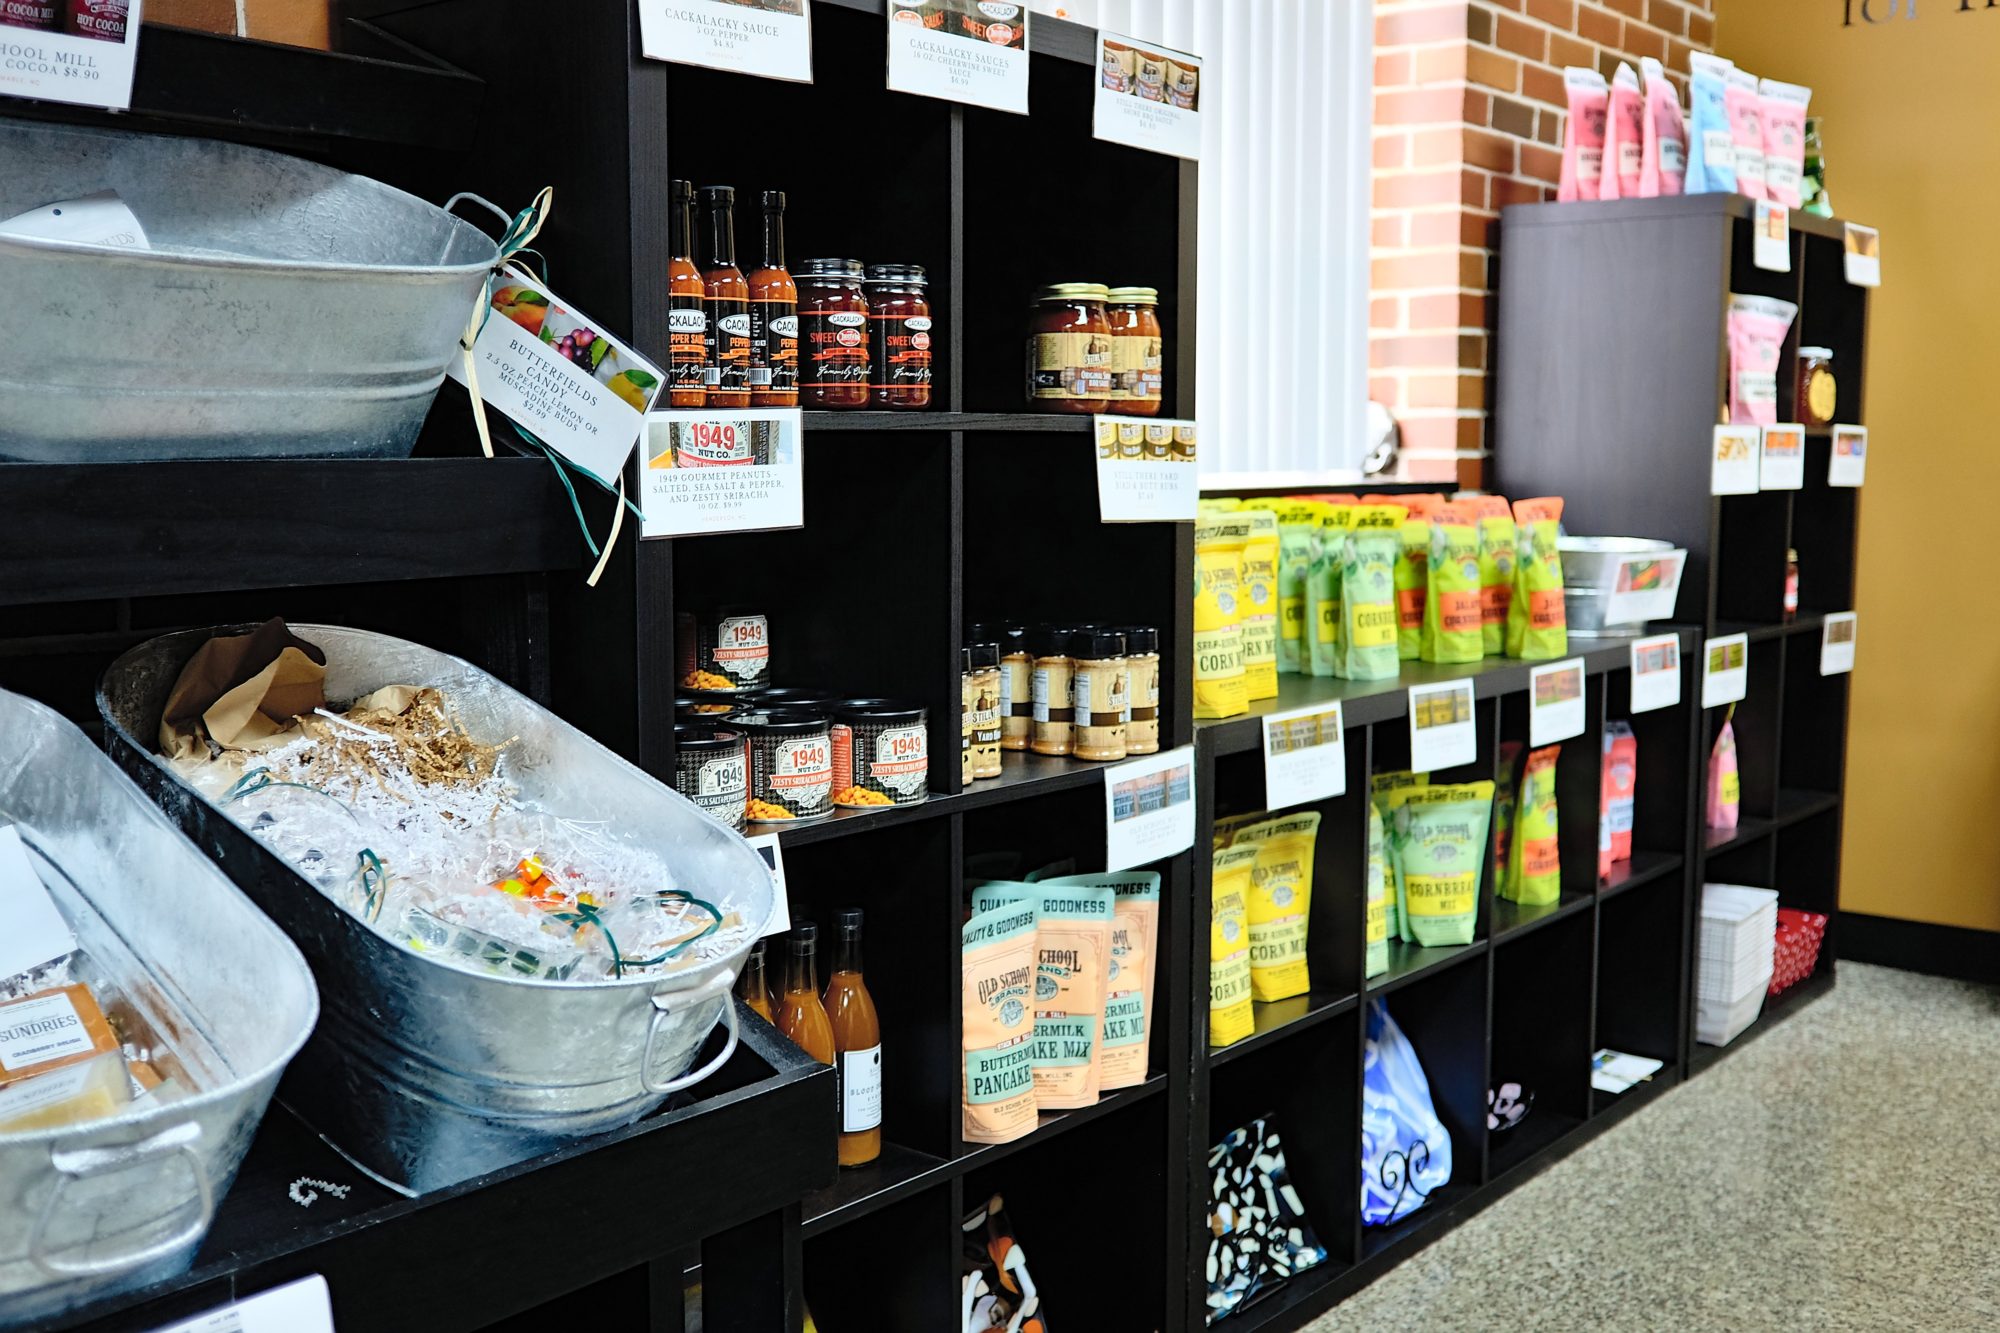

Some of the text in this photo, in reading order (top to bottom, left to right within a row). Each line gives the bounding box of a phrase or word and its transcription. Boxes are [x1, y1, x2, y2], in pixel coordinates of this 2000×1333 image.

[7, 2, 39, 17] COCOA
[77, 13, 125, 33] HOT COCOA
[665, 8, 739, 31] CACKALACKY
[743, 22, 779, 37] SAUCE
[55, 51, 97, 68] MILL
[910, 38, 1010, 69] CACKALACKY SAUCES
[5, 60, 99, 81] COCOA $8.90
[810, 332, 836, 343] SWEET
[887, 336, 911, 346] SWEET
[509, 339, 599, 406] BUTTERFIELDS
[526, 366, 568, 399] CANDY
[486, 353, 500, 365] 2.5
[551, 398, 584, 424] LEMON
[585, 422, 599, 435] OR
[499, 373, 579, 432] MUSCADINE BUDS
[522, 400, 547, 420] $2.99
[691, 423, 735, 450] 1949
[698, 449, 731, 459] NUT CO.
[659, 473, 678, 483] 1949
[681, 471, 726, 482] GOURMET
[730, 470, 771, 480] PEANUTS
[652, 483, 691, 494] SALTED,
[694, 482, 711, 492] SEA
[714, 481, 737, 491] SALT
[740, 481, 746, 489] &
[670, 490, 769, 504] AND ZESTY SRIRACHA
[732, 625, 762, 642] 1949
[1200, 653, 1235, 673] CORN
[891, 736, 921, 755] 1949
[791, 748, 824, 768] 1949
[715, 765, 743, 787] 1949
[1043, 899, 1106, 914] GOODNESS
[987, 923, 994, 937] &
[996, 911, 1034, 934] GOODNESS
[1250, 944, 1286, 961] CORN
[978, 977, 999, 1005] OLD
[0, 1015, 78, 1042] SUNDRIES
[1063, 1041, 1091, 1058] MIX
[973, 1064, 1031, 1096] PANCAKE
